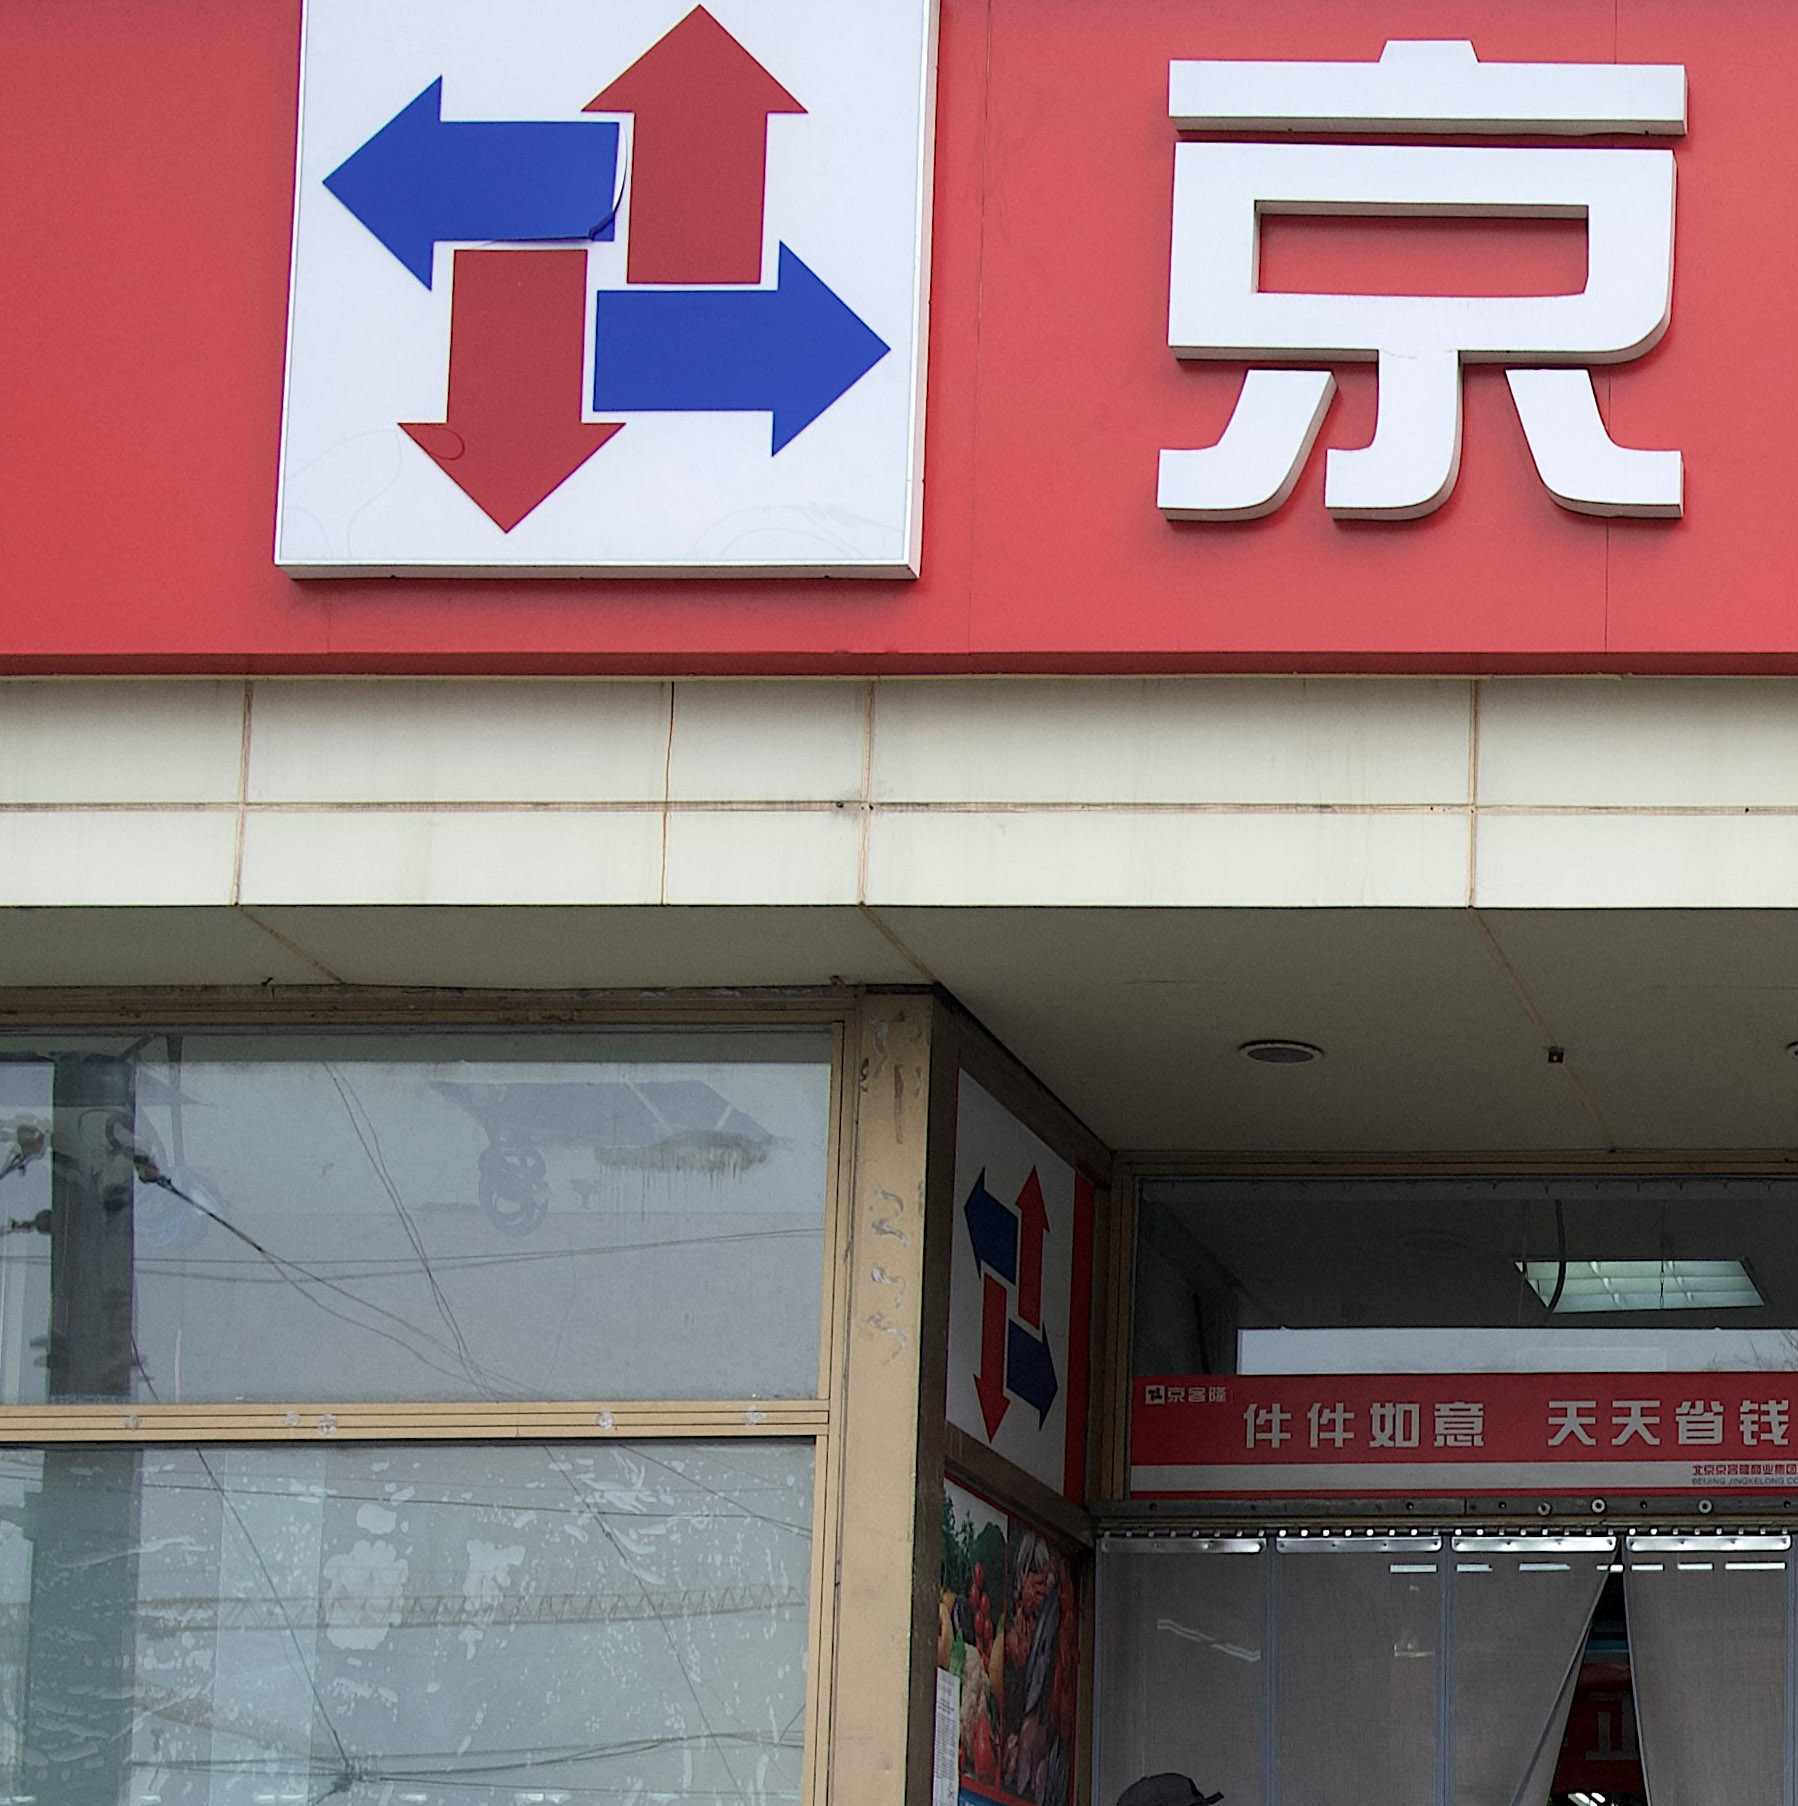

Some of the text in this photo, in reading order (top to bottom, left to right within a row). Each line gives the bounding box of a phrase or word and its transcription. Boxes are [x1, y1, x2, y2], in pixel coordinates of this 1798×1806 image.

[1168, 1386, 1226, 1403] 京客隆
[1243, 1399, 1790, 1449] 件件如意 天天省钱
